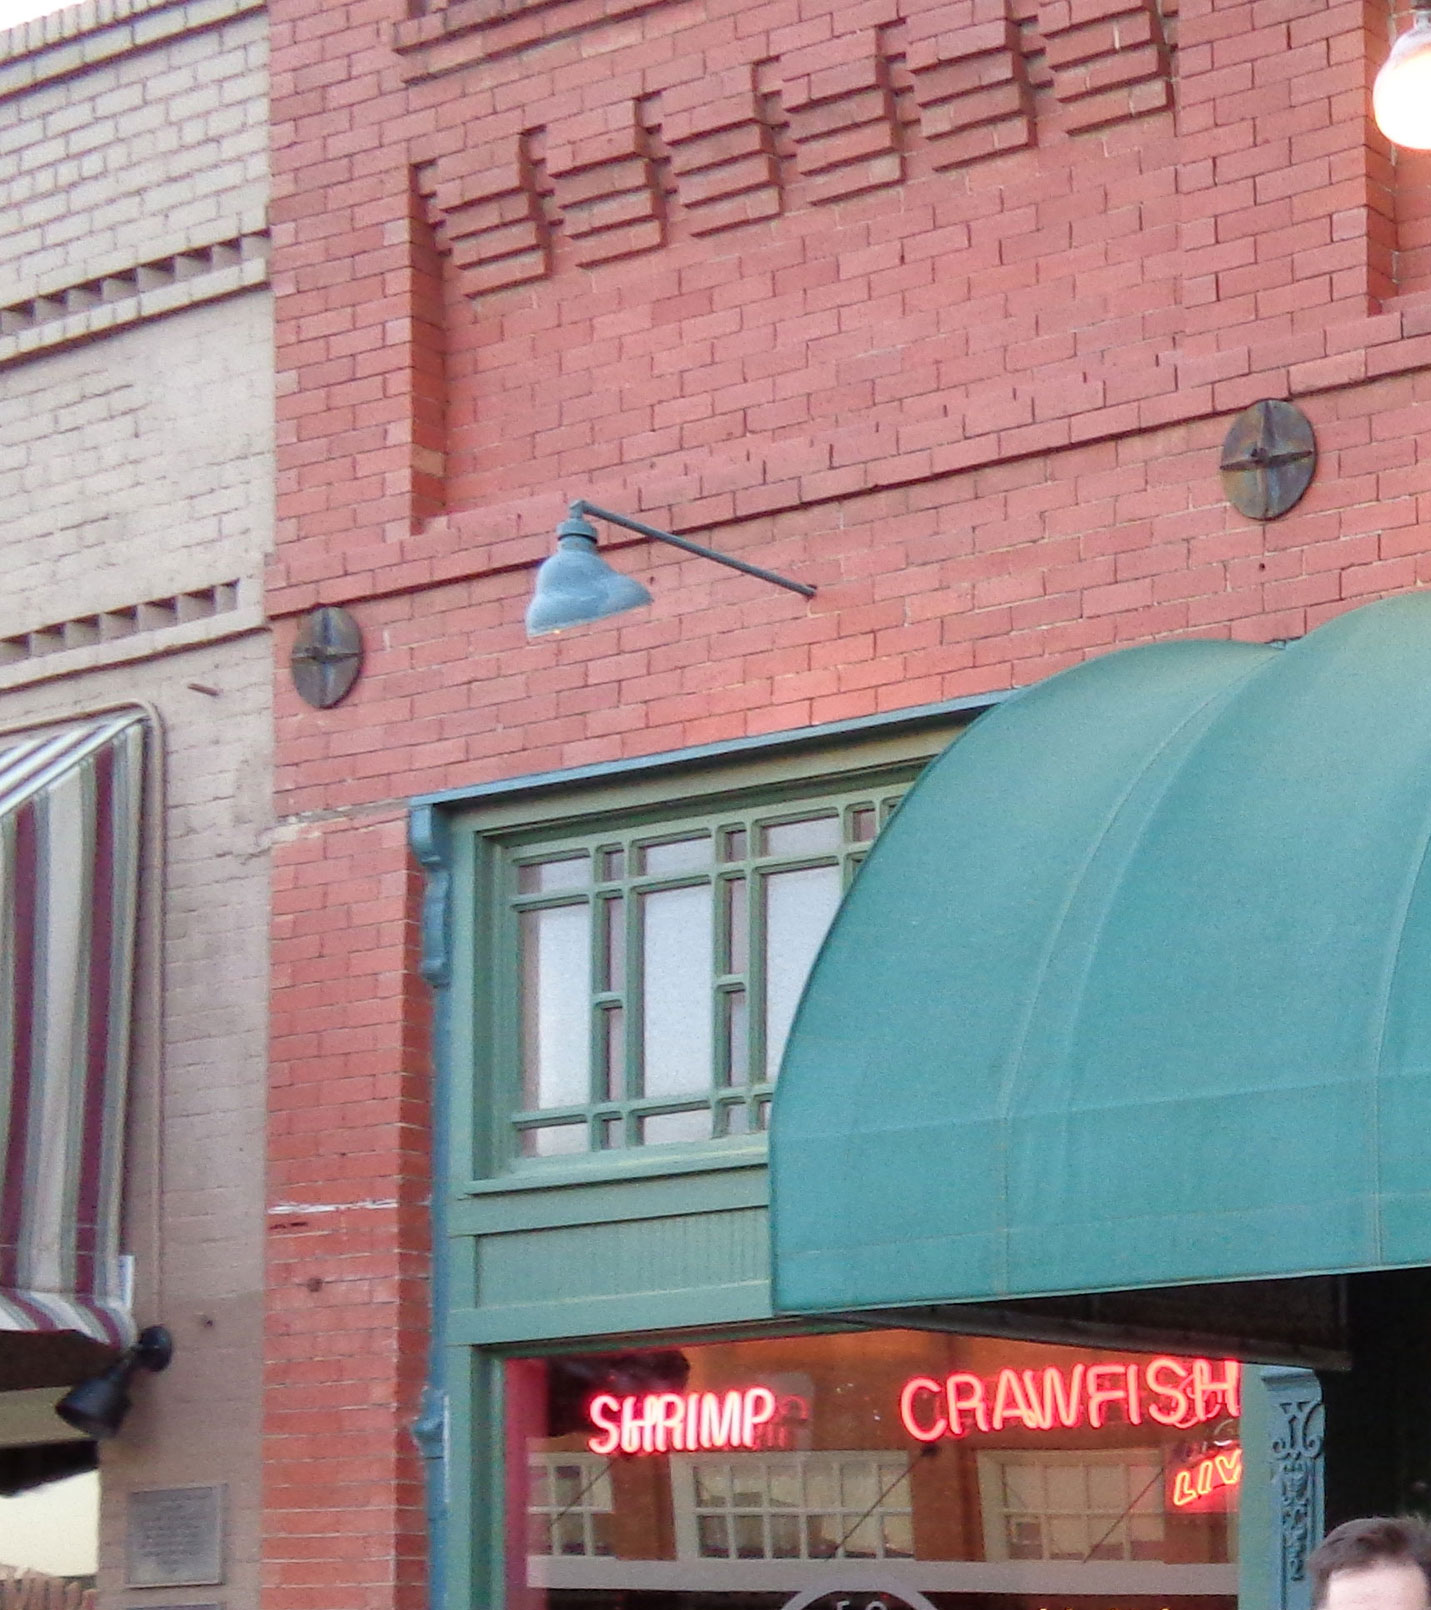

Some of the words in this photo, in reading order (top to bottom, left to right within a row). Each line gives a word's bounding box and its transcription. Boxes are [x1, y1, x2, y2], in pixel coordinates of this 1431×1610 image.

[587, 1386, 777, 1454] SHRIMP
[900, 1356, 1242, 1442] CRAWFISH
[1173, 1448, 1242, 1506] LIV
